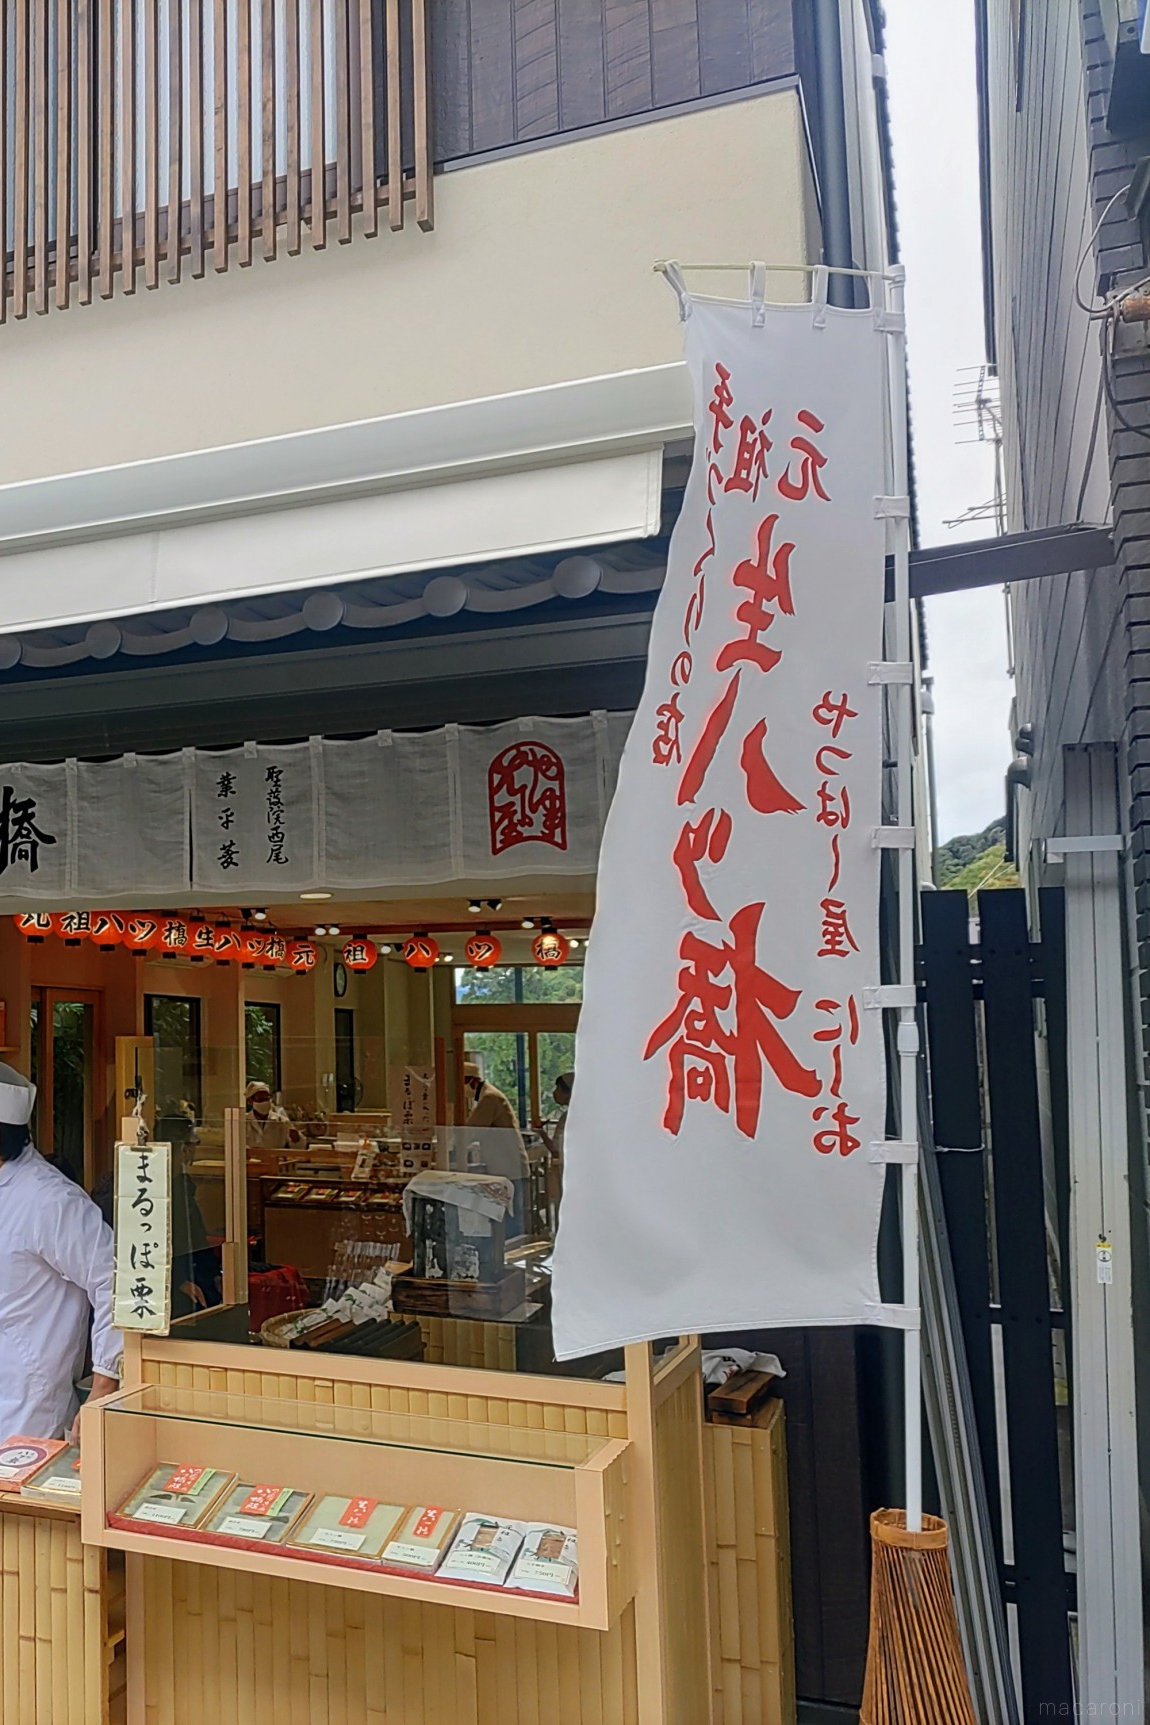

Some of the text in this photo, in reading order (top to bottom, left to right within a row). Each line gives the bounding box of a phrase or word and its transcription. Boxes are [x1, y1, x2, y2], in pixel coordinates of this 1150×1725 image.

[130, 1153, 160, 1320] まるっぽ栗
